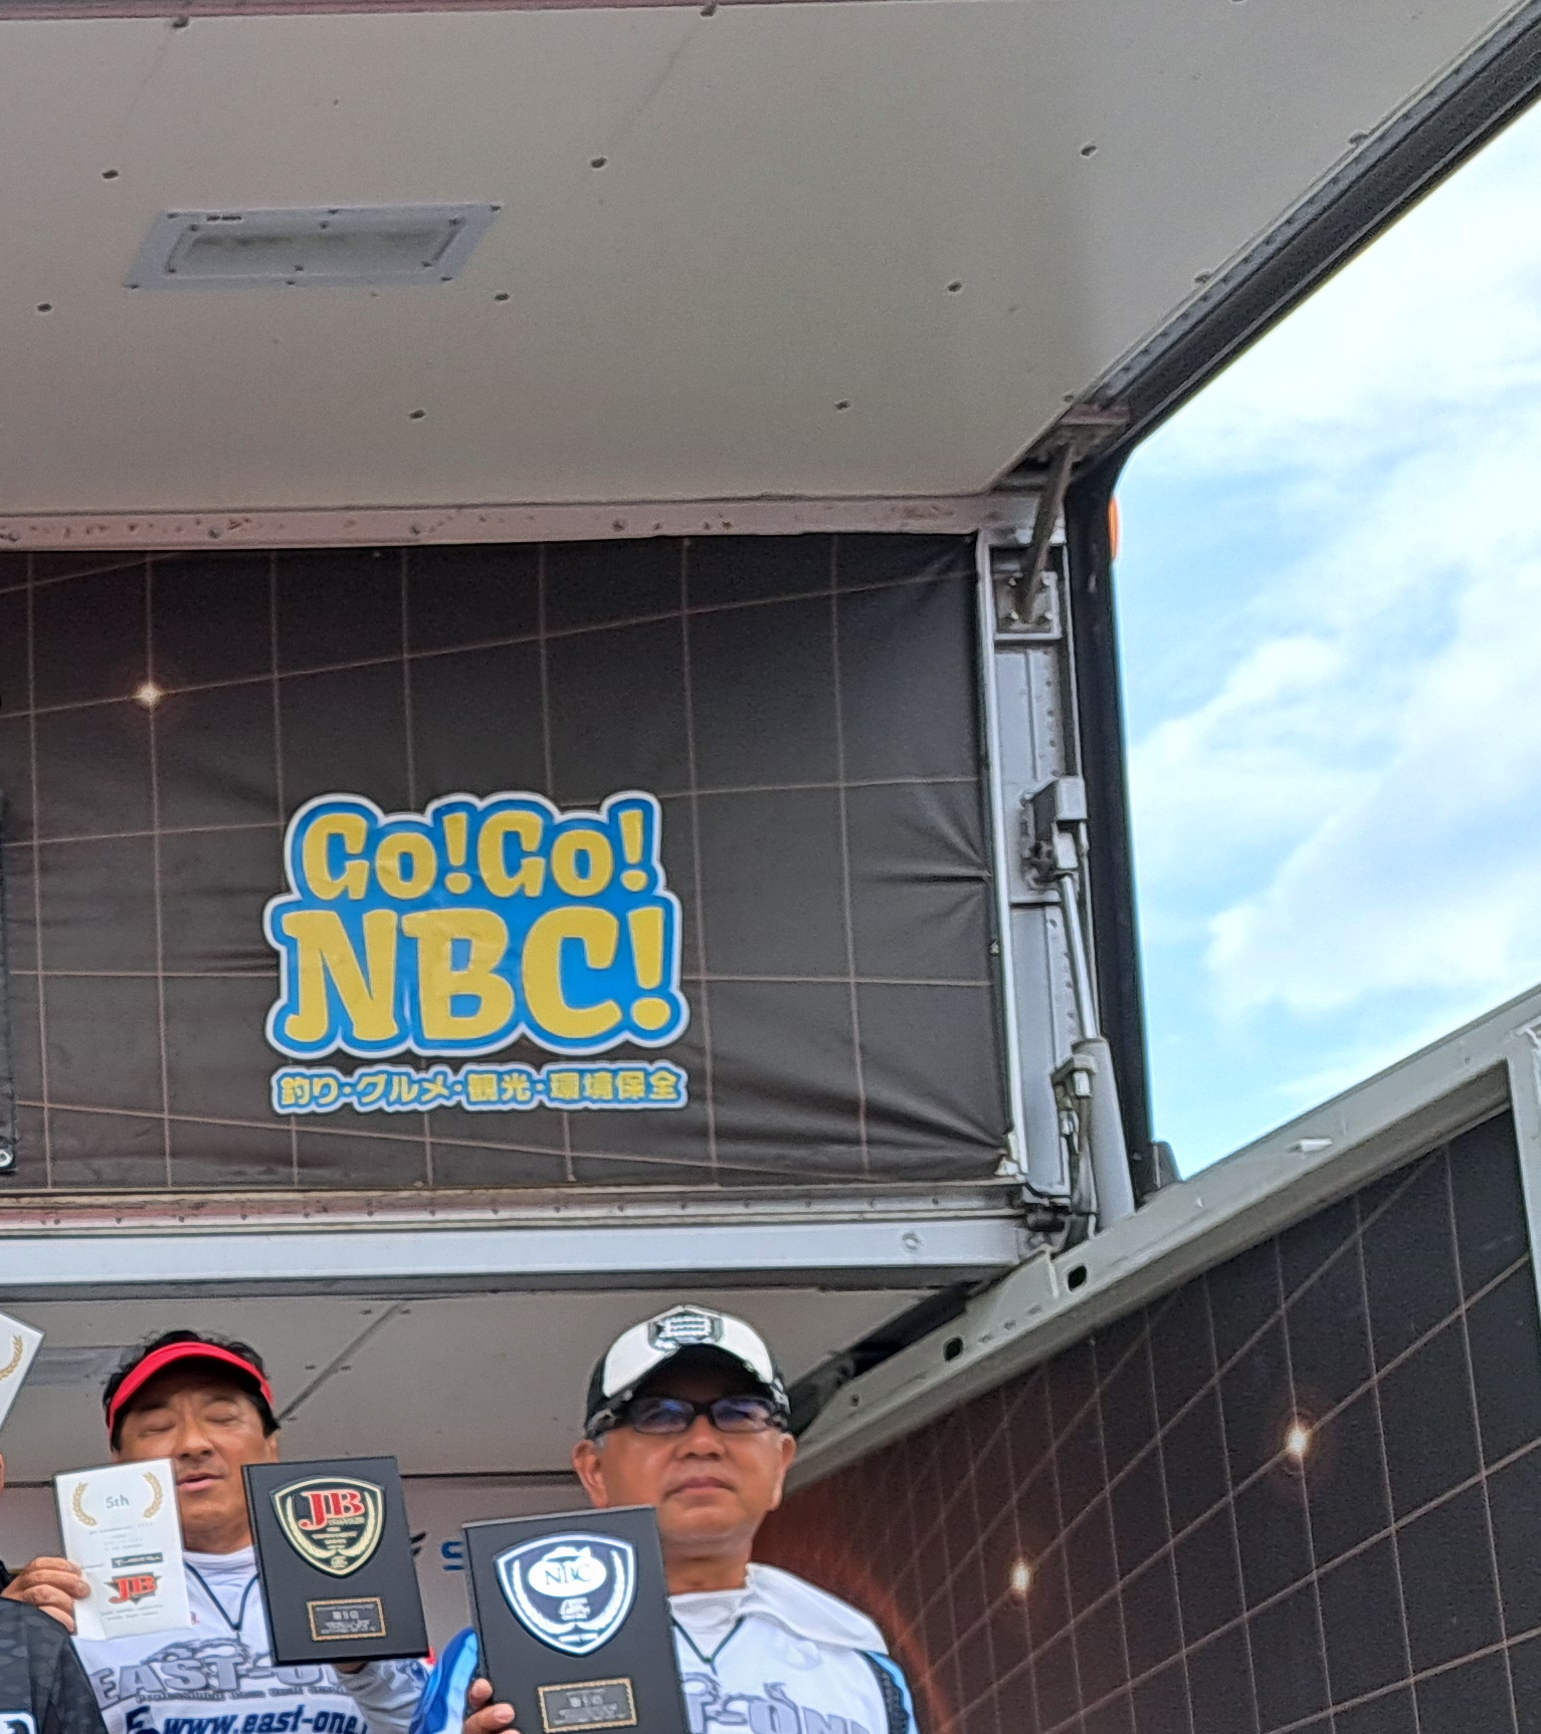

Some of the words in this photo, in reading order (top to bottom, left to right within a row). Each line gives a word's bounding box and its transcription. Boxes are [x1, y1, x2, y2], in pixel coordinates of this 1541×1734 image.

[302, 808, 649, 901] Go!Go!
[281, 905, 665, 1042] NBC!
[297, 1488, 366, 1531] JB
[108, 1574, 158, 1604] JB
